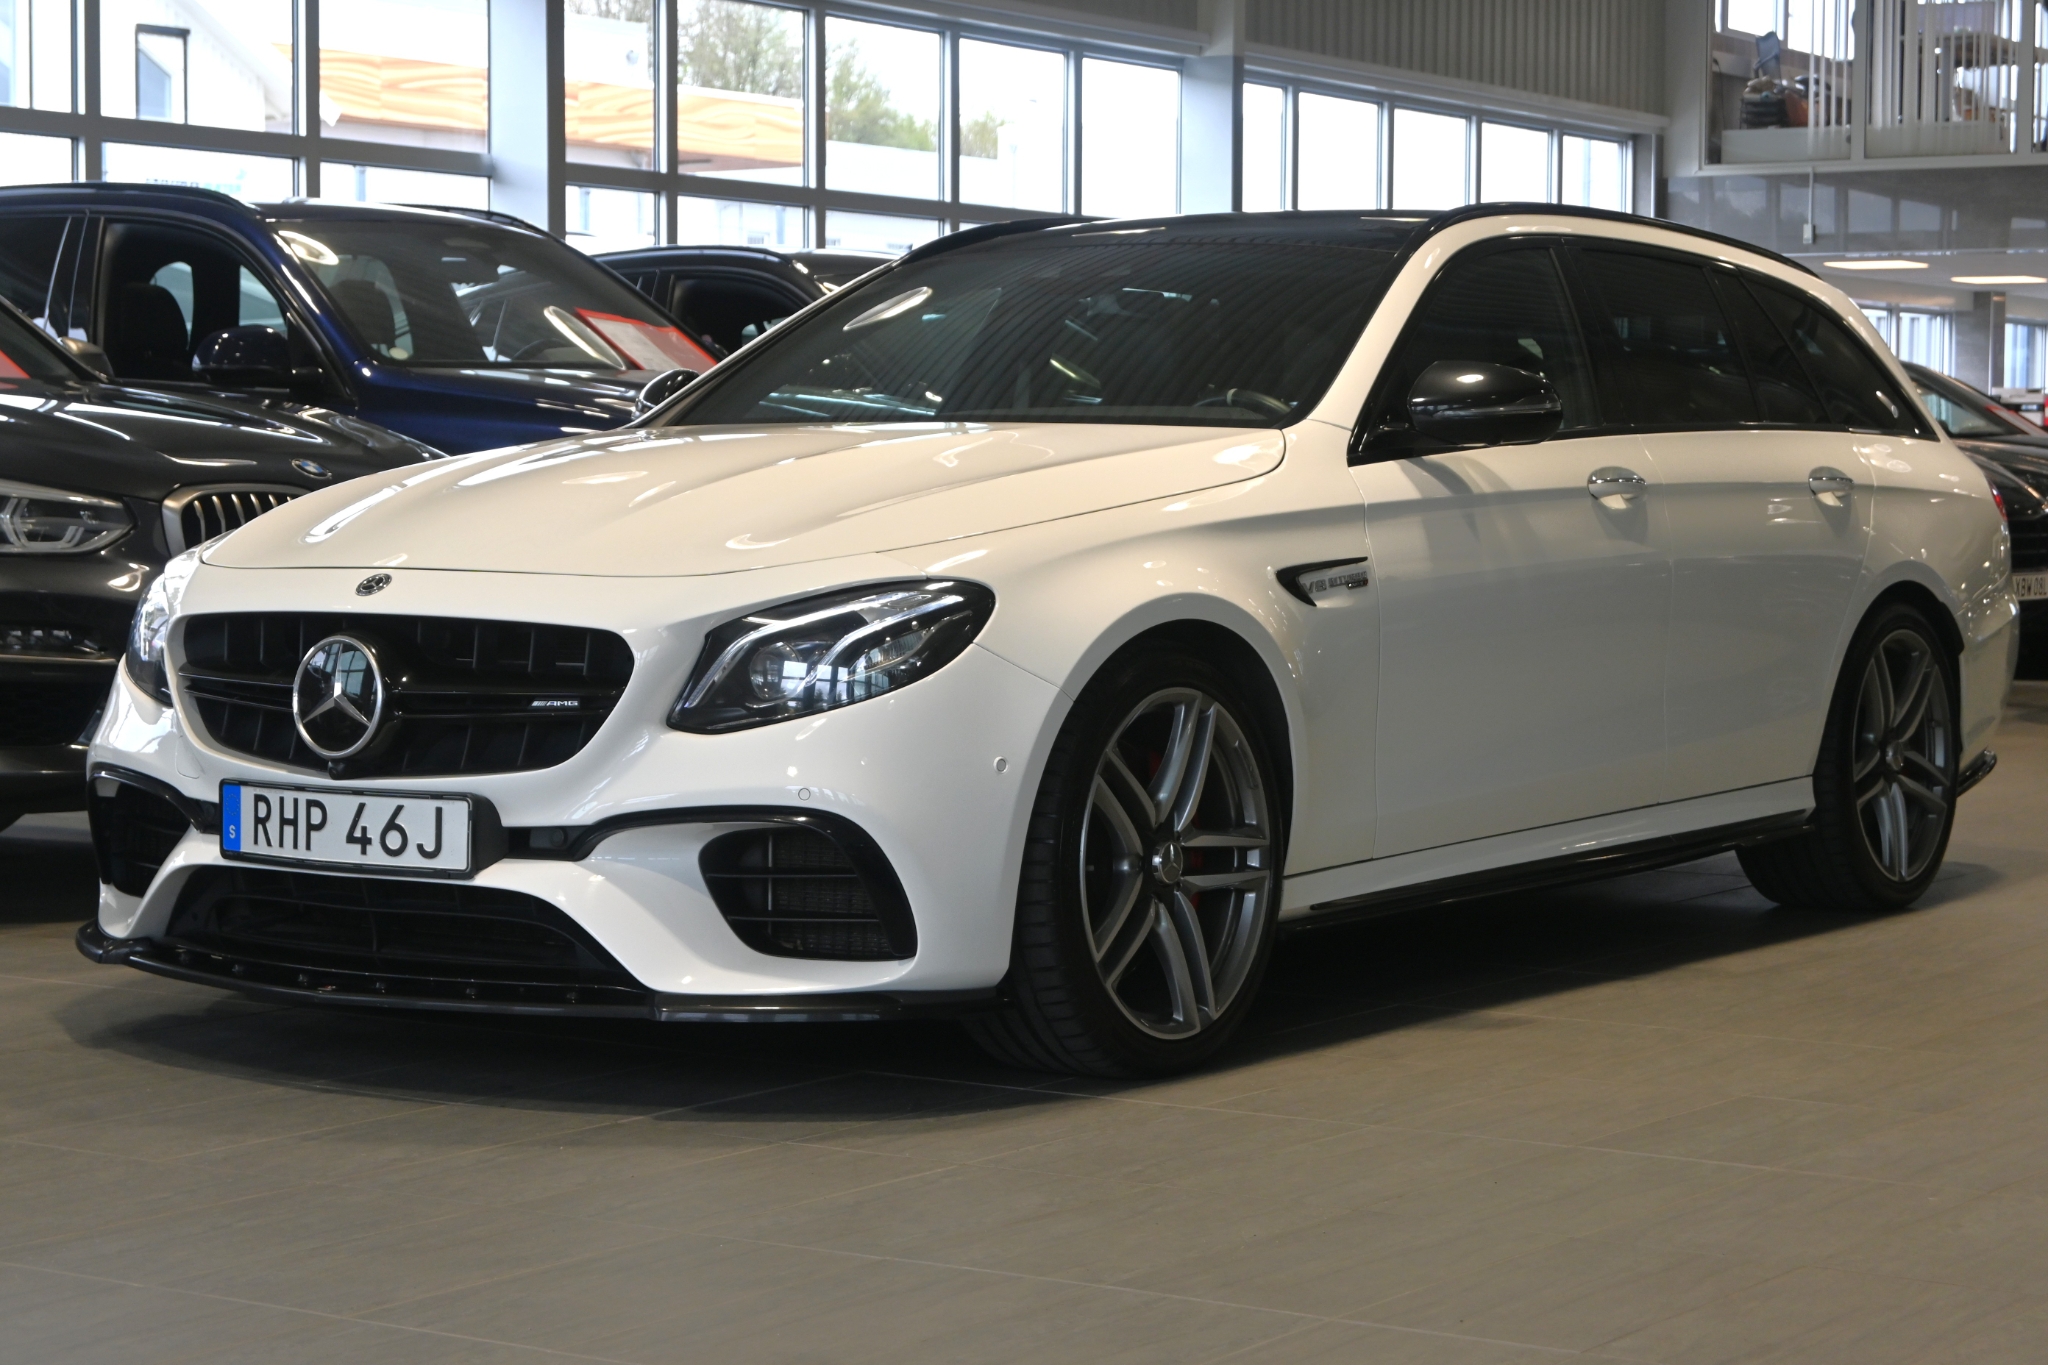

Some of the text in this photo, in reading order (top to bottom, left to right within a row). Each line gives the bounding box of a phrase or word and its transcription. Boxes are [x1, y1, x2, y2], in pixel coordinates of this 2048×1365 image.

[229, 825, 236, 839] S
[253, 793, 443, 860] RHP 46J
